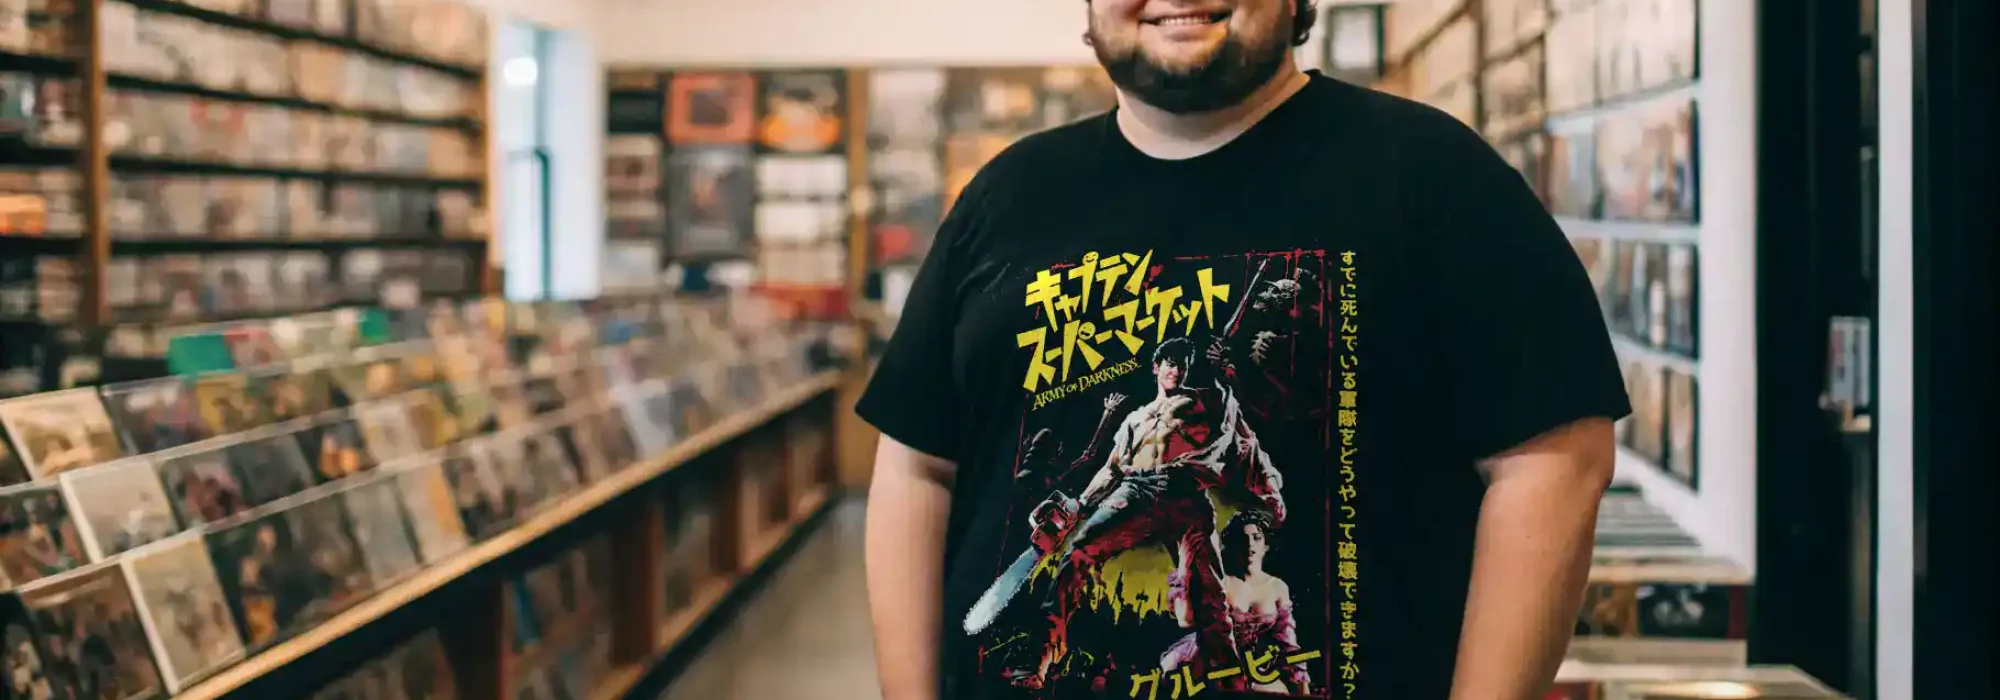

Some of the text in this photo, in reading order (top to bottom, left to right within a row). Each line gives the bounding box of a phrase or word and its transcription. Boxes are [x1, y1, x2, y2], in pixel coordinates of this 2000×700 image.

[1025, 249, 1153, 332] キャプテン
[1016, 267, 1230, 393] スーパーマーケット
[1031, 384, 1066, 412] ARMY
[1077, 357, 1139, 392] DARKNESS
[1129, 645, 1321, 700] グルービー
